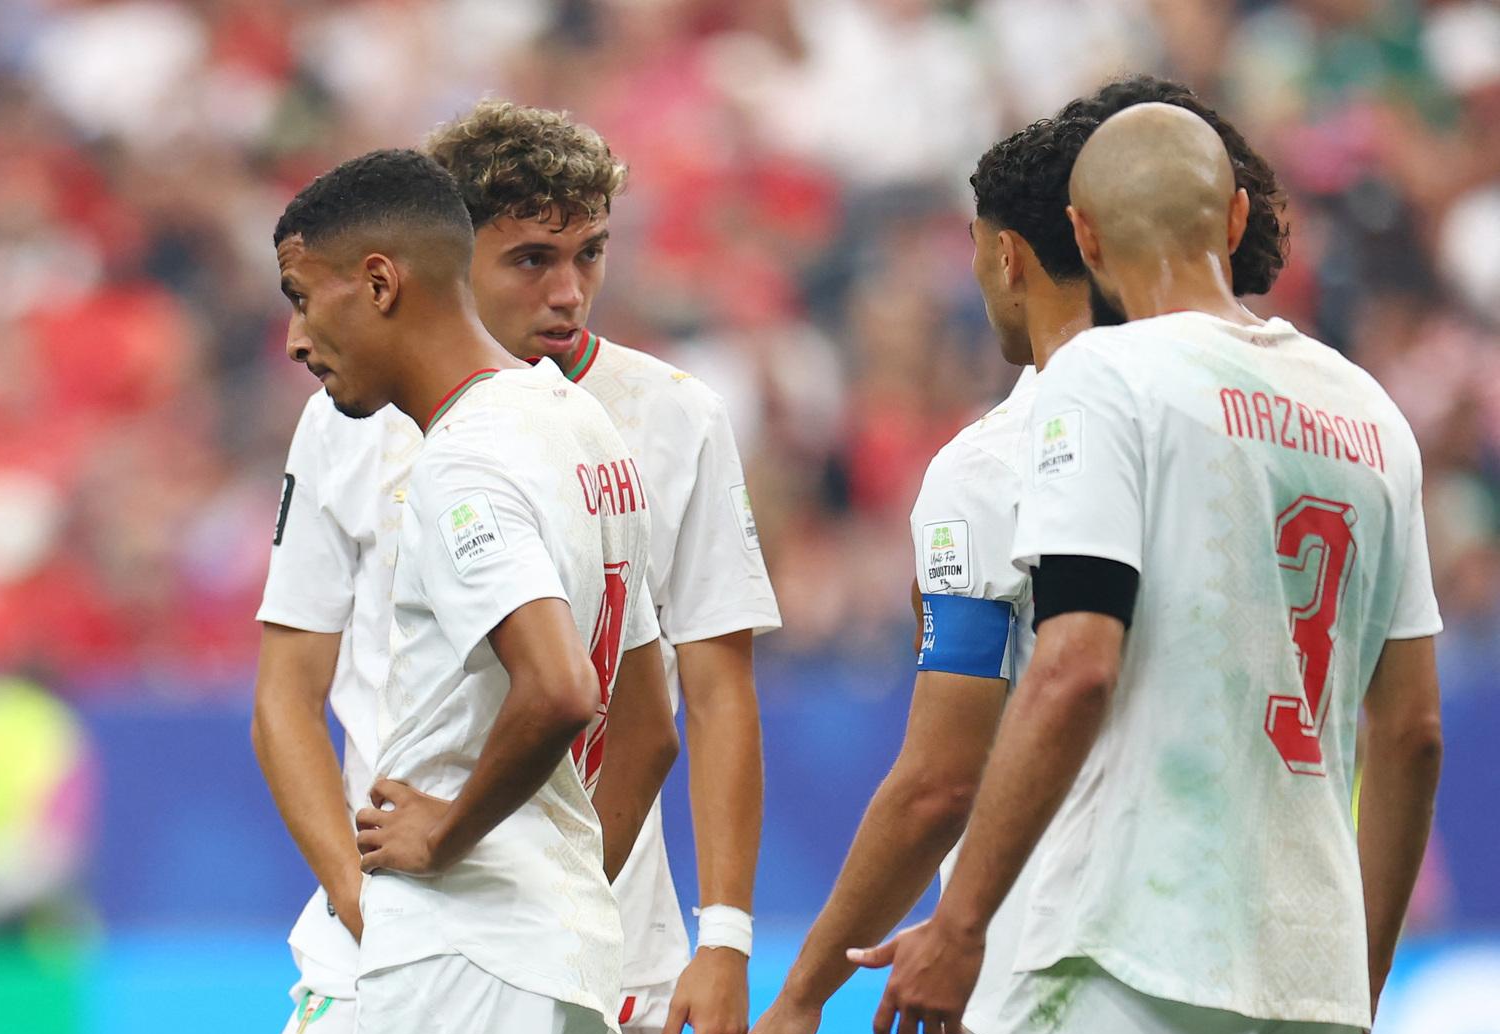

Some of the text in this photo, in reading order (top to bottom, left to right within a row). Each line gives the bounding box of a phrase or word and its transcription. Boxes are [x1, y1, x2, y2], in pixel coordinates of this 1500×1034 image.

[1219, 387, 1385, 474] MAZRAOUI
[454, 532, 496, 560] EDUCATION
[1264, 494, 1358, 777] 3
